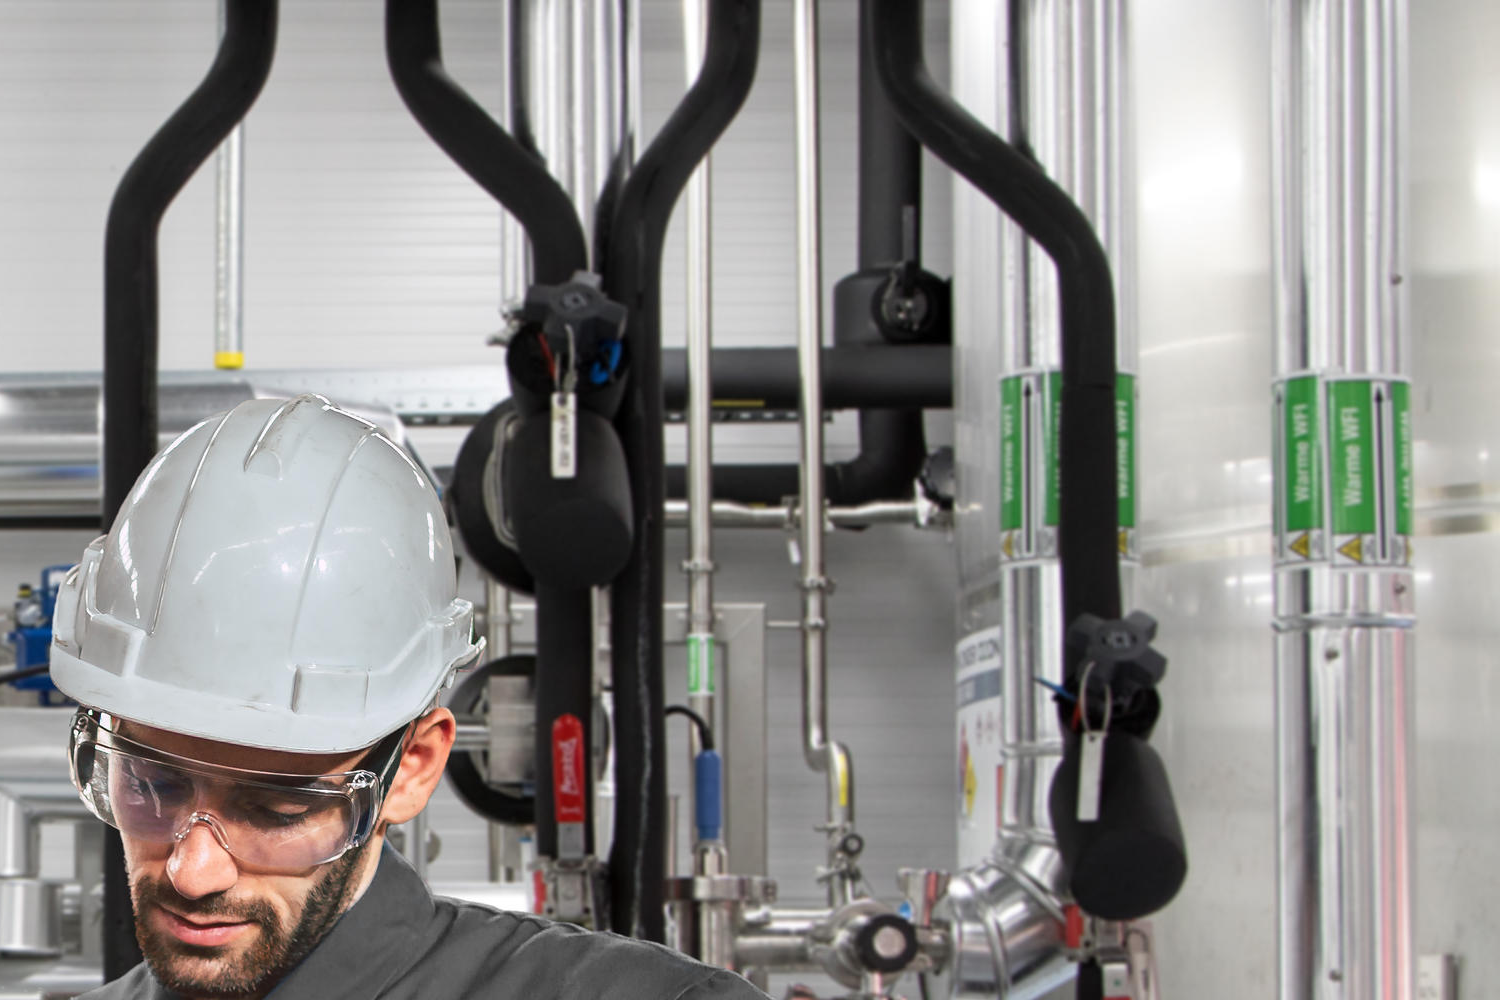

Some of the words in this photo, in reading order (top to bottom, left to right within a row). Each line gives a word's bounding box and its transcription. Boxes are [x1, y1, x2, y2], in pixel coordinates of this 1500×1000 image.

[1292, 403, 1309, 438] WFI
[1340, 407, 1360, 442] WFI
[1294, 441, 1310, 503] Warme
[1343, 444, 1362, 507] Warme
